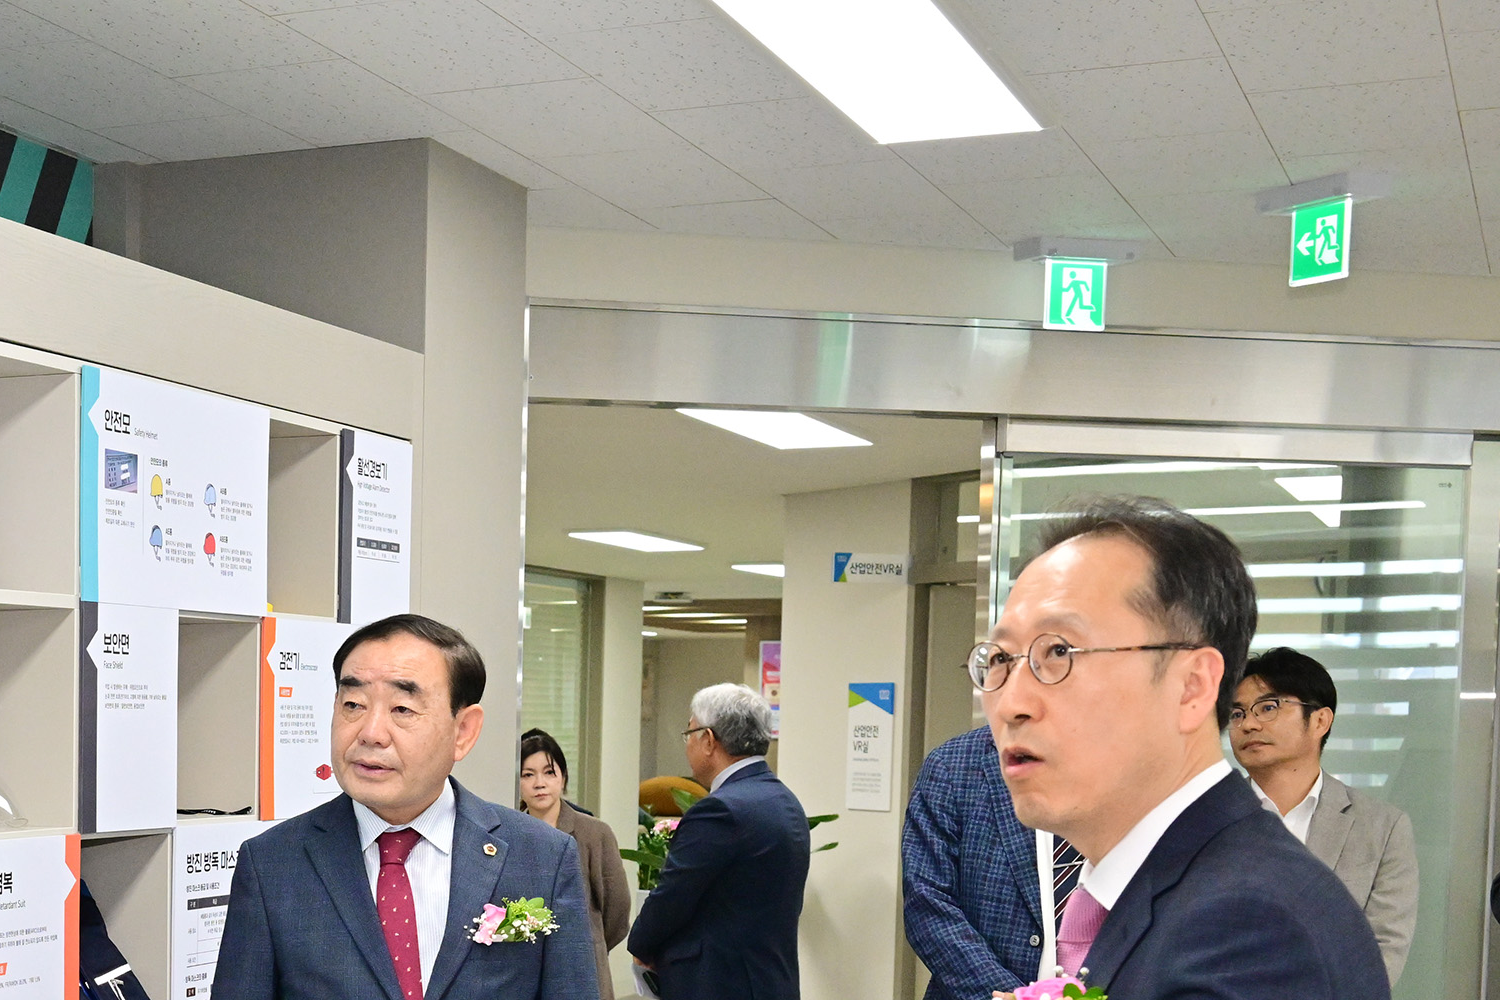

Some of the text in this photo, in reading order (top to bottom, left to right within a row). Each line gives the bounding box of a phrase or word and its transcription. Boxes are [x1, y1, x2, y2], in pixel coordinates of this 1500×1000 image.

[104, 409, 131, 435] 안전모
[357, 457, 388, 480] 활선경보기
[850, 562, 903, 576] 산업안전VR실
[103, 633, 129, 655] 보안면
[279, 651, 300, 671] 검전기
[853, 725, 879, 738] 산업안전
[853, 740, 869, 754] VR실
[186, 853, 202, 874] 방진
[204, 852, 219, 872] 방독
